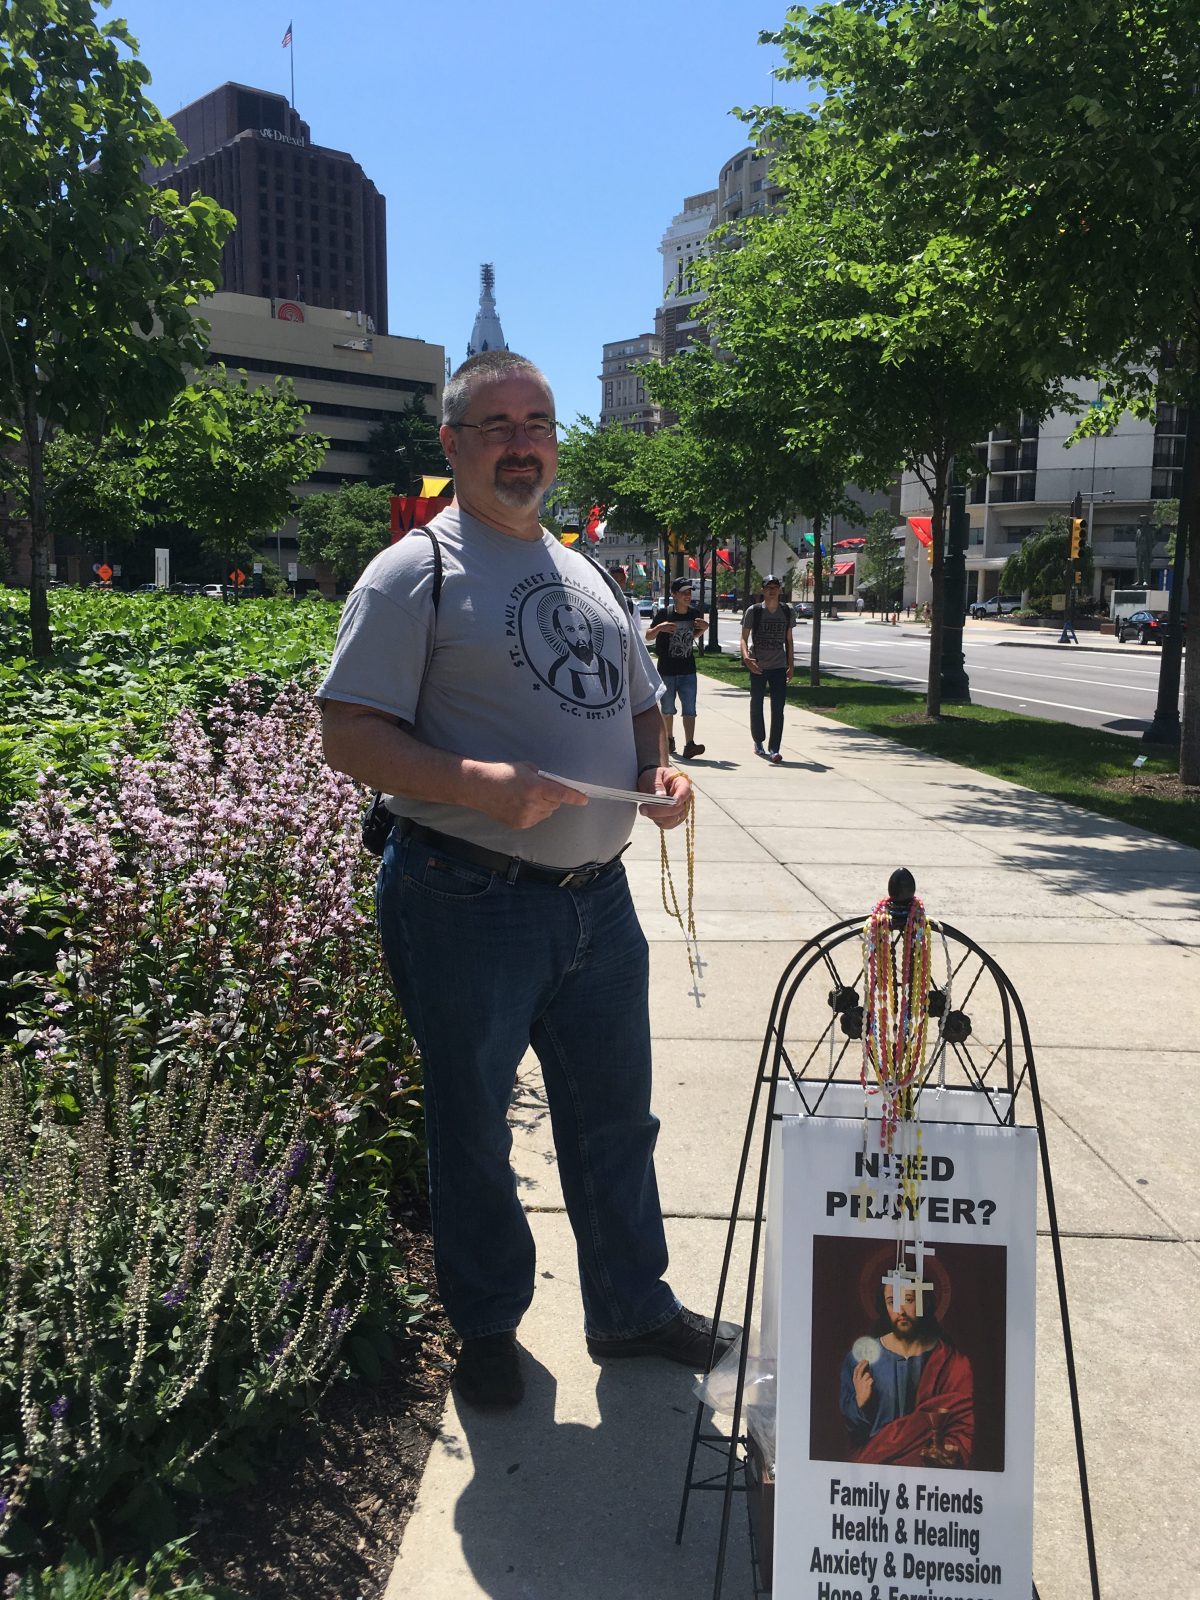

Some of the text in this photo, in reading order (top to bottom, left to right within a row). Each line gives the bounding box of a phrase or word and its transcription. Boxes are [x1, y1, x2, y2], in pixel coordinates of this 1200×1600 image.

[274, 130, 304, 147] Drexel
[510, 573, 545, 601] STREET
[505, 604, 517, 636] PAUL
[830, 1479, 983, 1515] Family & Friends
[832, 1513, 980, 1556] Health & Healing
[809, 1546, 1002, 1587] Anxiety & Depression
